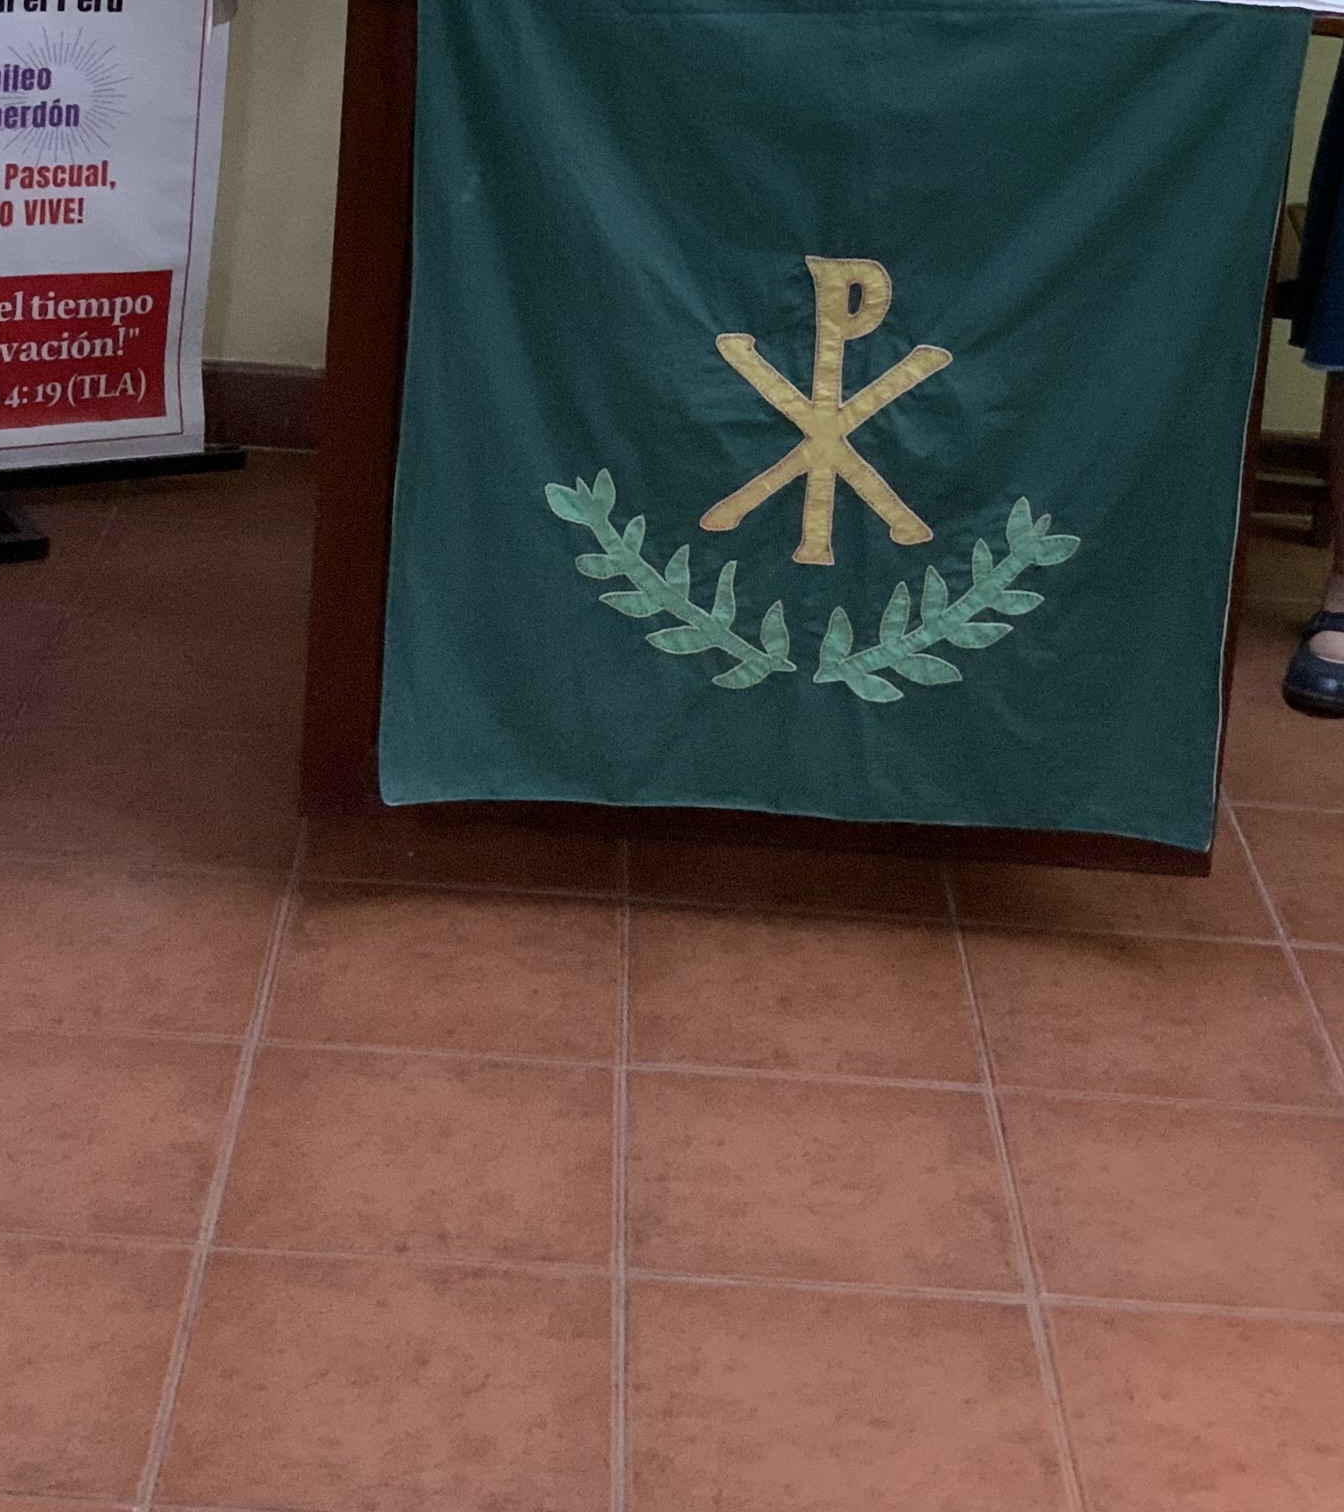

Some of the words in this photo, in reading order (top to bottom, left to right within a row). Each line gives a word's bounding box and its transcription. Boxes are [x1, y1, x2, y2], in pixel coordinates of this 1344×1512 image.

[4, 160, 117, 190] Pascual,
[24, 197, 85, 226] VIVE!
[31, 291, 154, 326] tiempo
[67, 368, 147, 408] (TLA)
